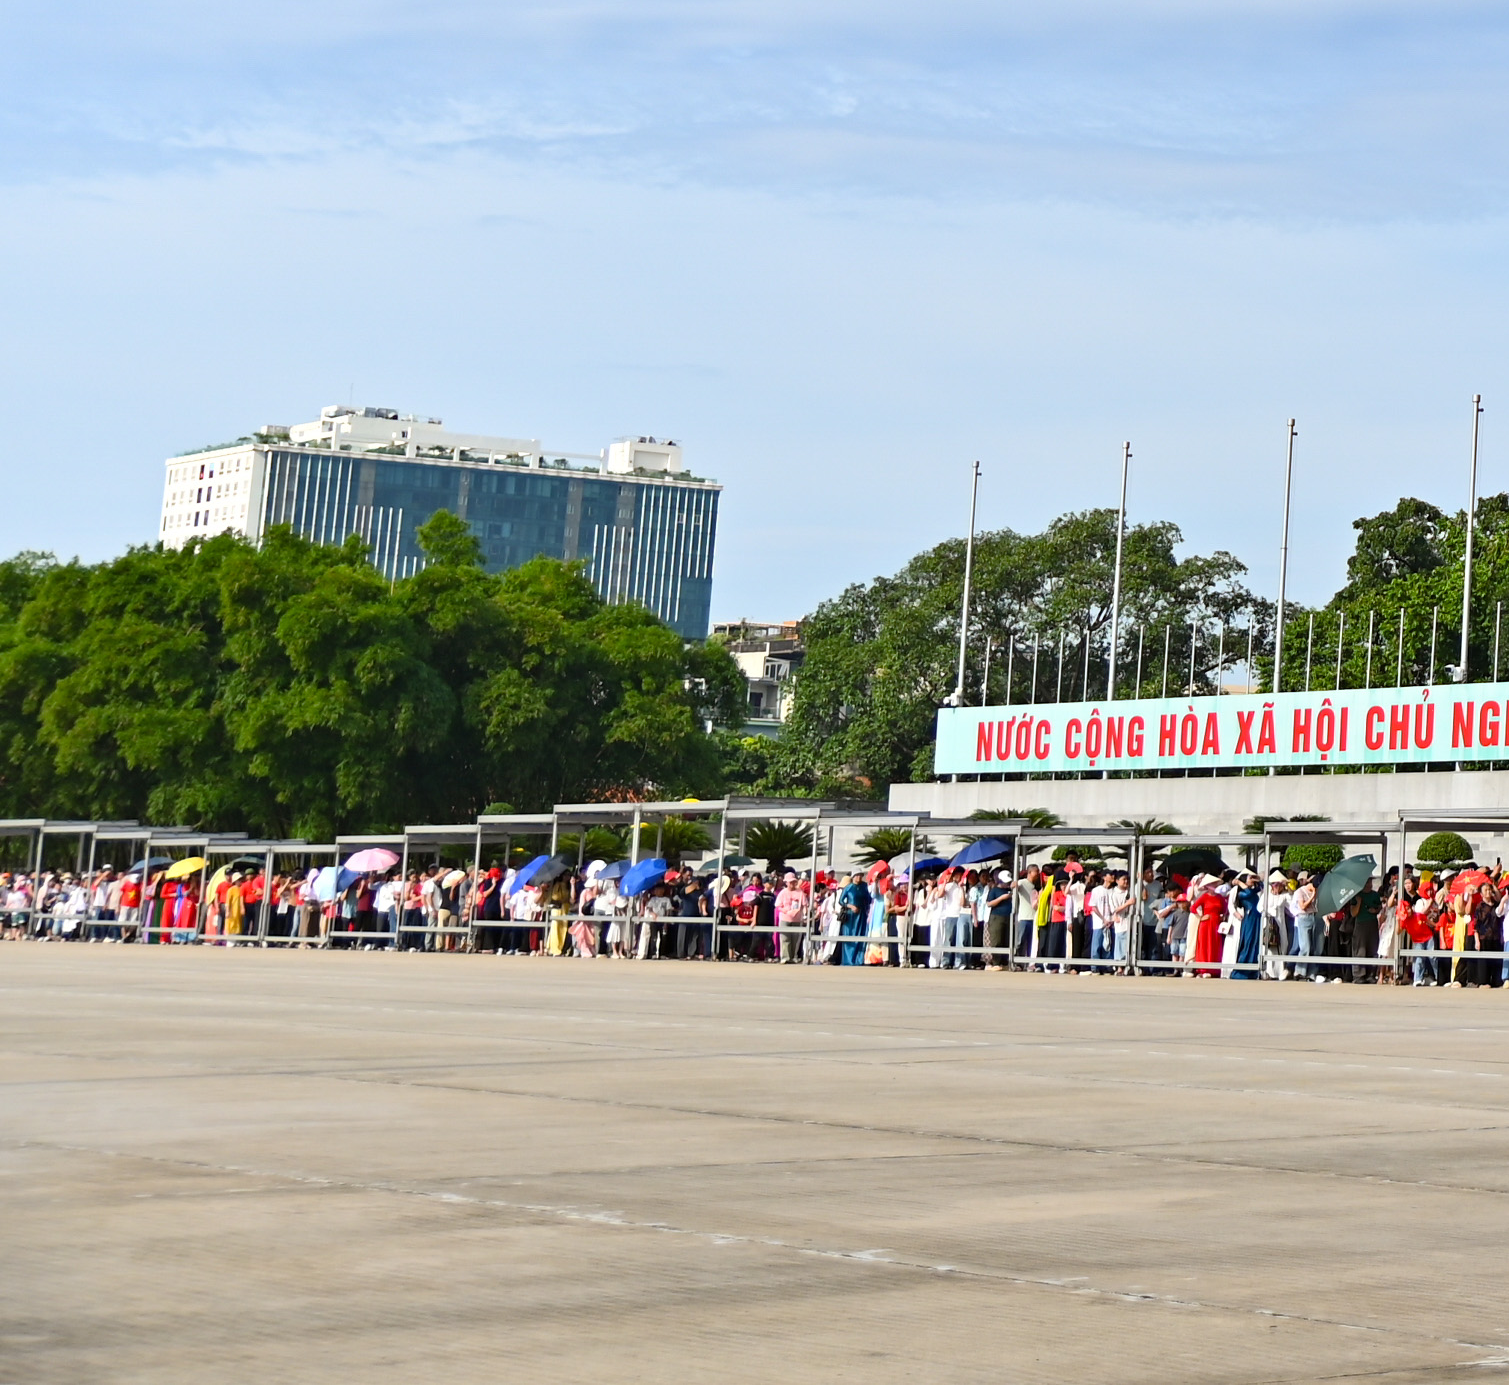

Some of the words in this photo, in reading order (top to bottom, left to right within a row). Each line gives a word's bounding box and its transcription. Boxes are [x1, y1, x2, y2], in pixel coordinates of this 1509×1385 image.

[976, 711, 1051, 762] NƯỚC
[1066, 709, 1145, 767] CỘNG
[1160, 705, 1220, 757] HÒA
[1235, 702, 1277, 755] XÃ
[1292, 698, 1349, 761] HỘI
[1365, 689, 1435, 751] CHỦ
